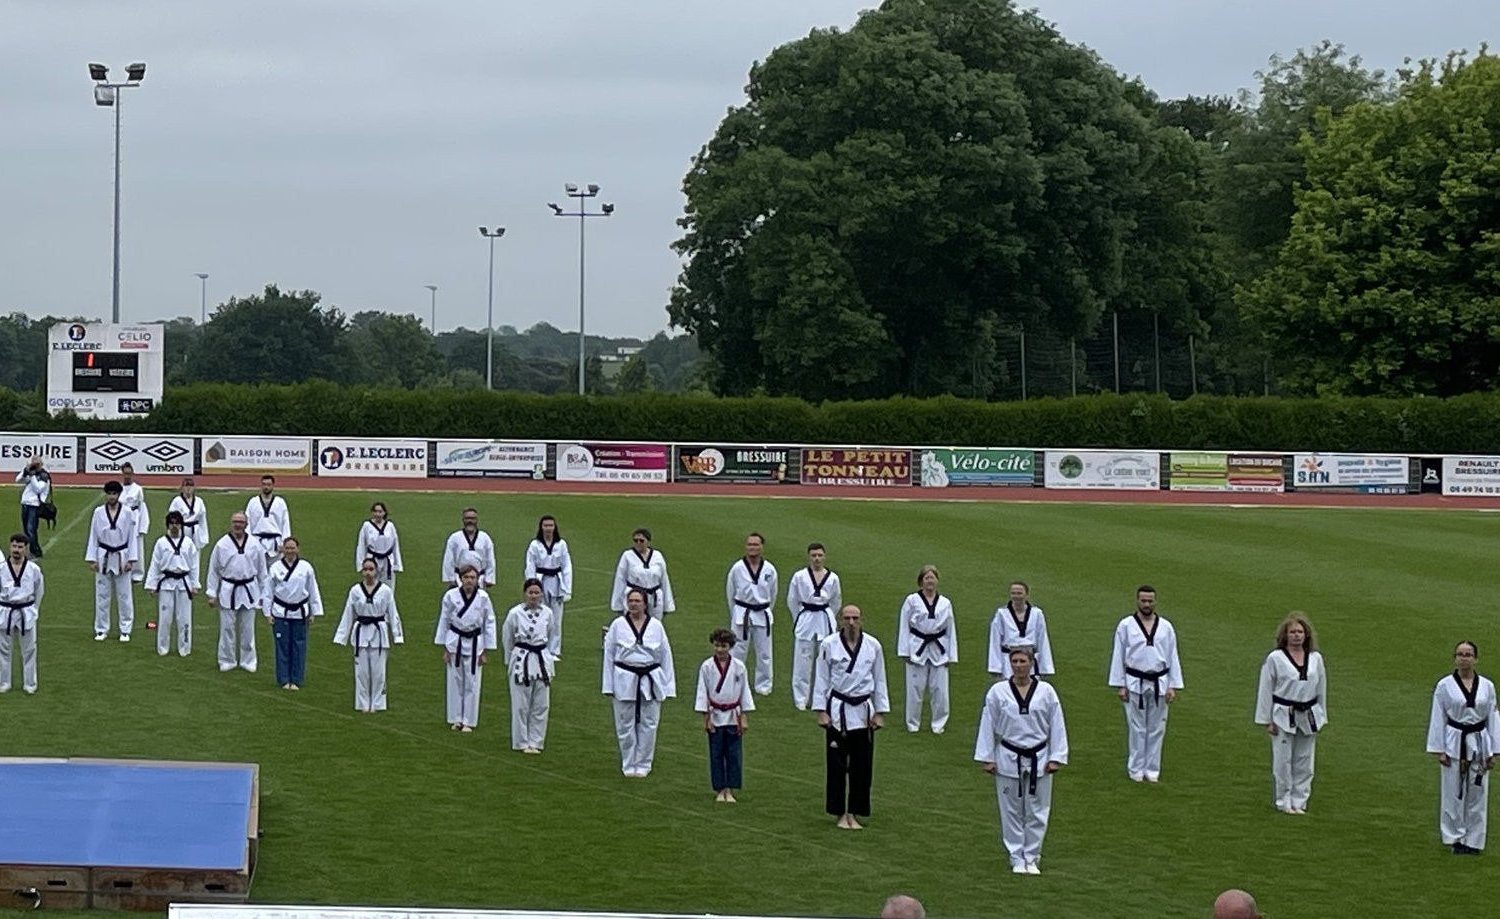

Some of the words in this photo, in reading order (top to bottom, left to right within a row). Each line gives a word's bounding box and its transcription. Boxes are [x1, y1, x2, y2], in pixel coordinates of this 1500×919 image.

[230, 449, 272, 457] RAISON
[275, 450, 306, 458] HOME
[736, 450, 787, 463] BRESSUIRE
[807, 450, 834, 463] LE
[843, 450, 907, 464] PETIT
[146, 463, 185, 472] umbro
[950, 453, 1031, 471] Vélo-cité
[1458, 460, 1500, 468] RENAULT
[803, 465, 909, 478] TONNEAU
[817, 477, 896, 486] BRESSUIRE
